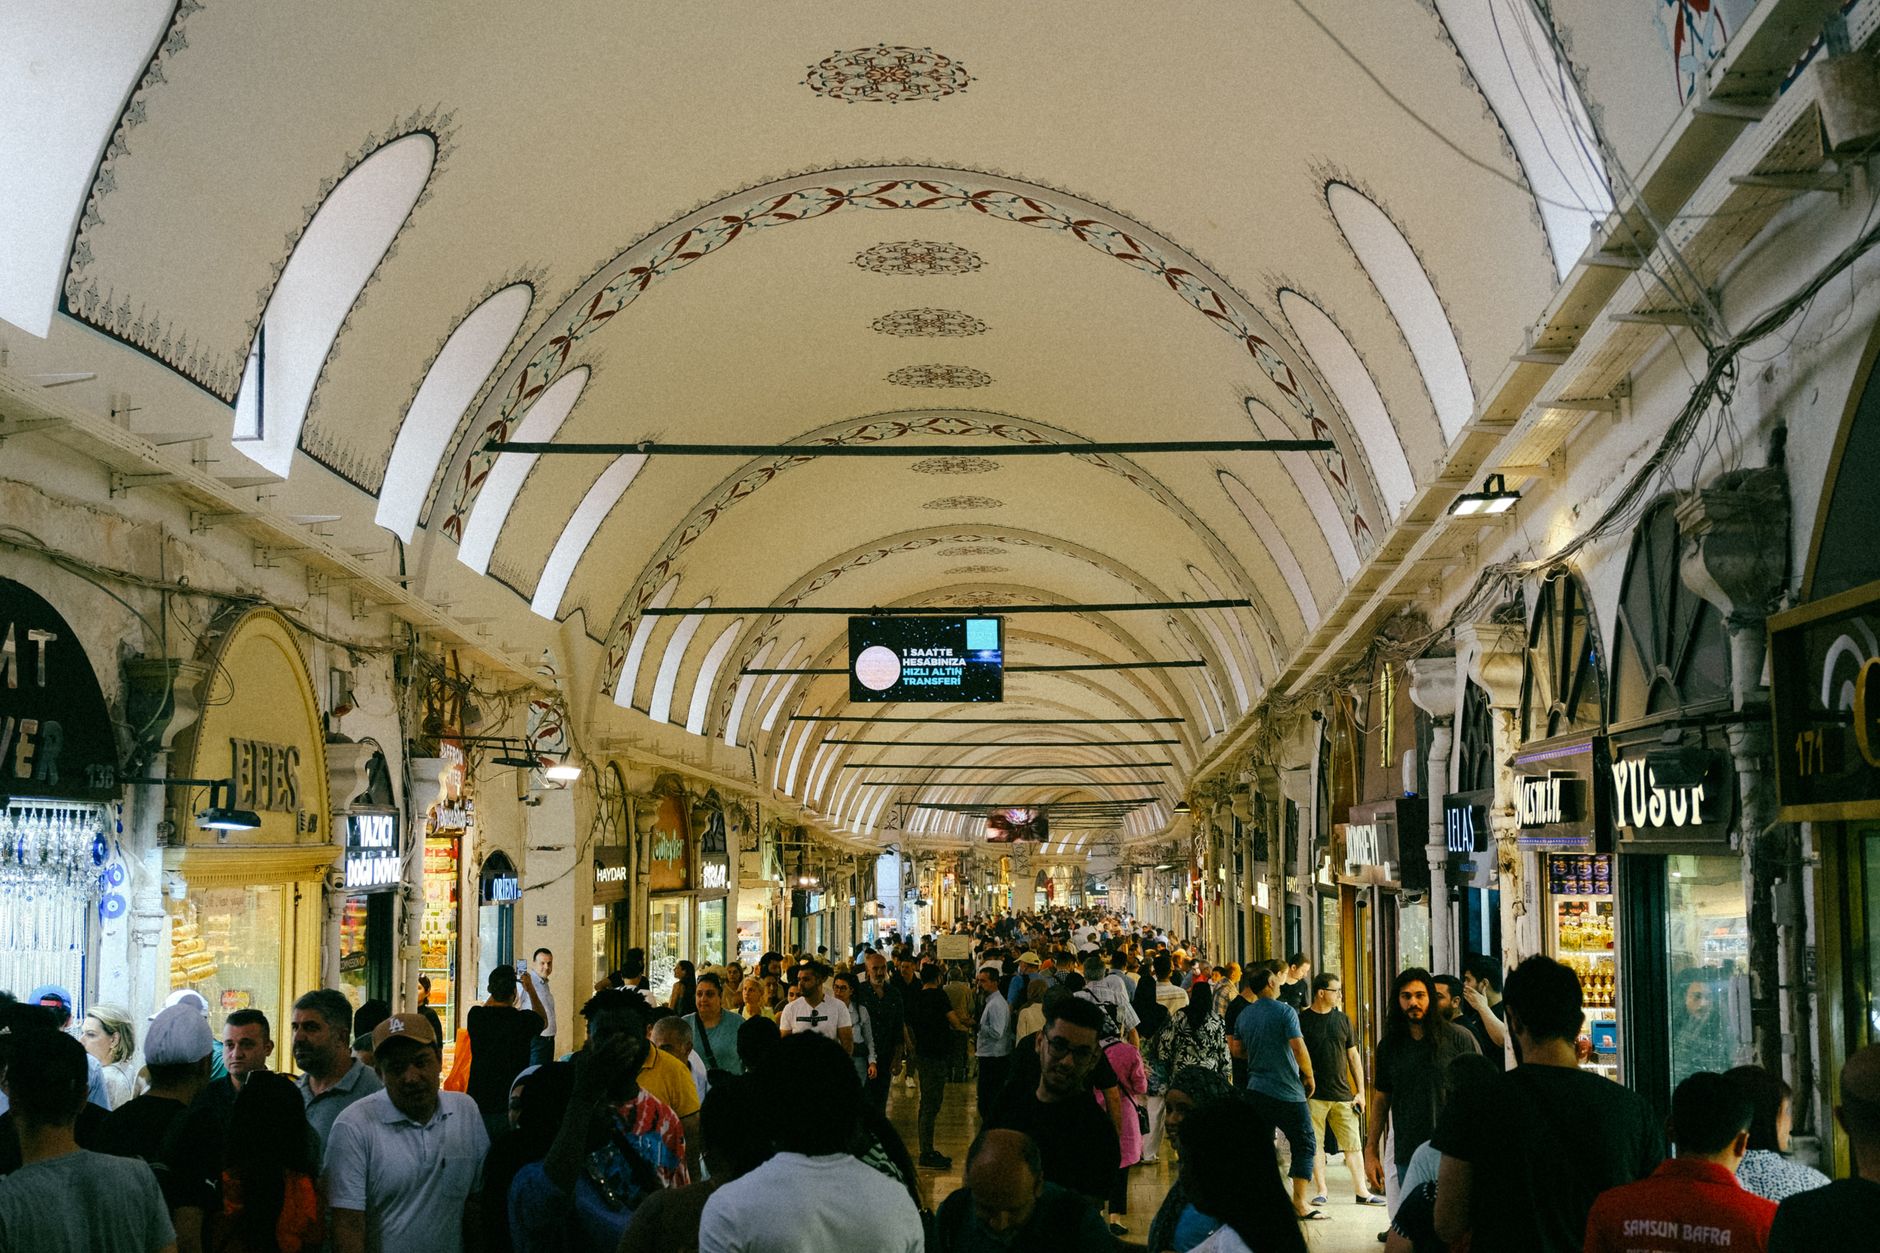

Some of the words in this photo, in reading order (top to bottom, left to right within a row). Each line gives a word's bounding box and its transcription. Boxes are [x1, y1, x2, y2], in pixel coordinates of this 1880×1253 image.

[903, 648, 908, 657] 1
[910, 648, 954, 657] SAATTE
[902, 667, 929, 676] HIZLI
[931, 667, 963, 676] ALTIN
[902, 674, 961, 686] TRANSFERİ
[1796, 727, 1824, 776] 171
[229, 737, 301, 814] EFES
[359, 815, 393, 848] YAZICI
[596, 866, 627, 883] HAYDAR
[389, 1017, 405, 1034] LA
[1622, 1219, 1679, 1239] SAMSUN
[1682, 1223, 1732, 1246] BAFRA
